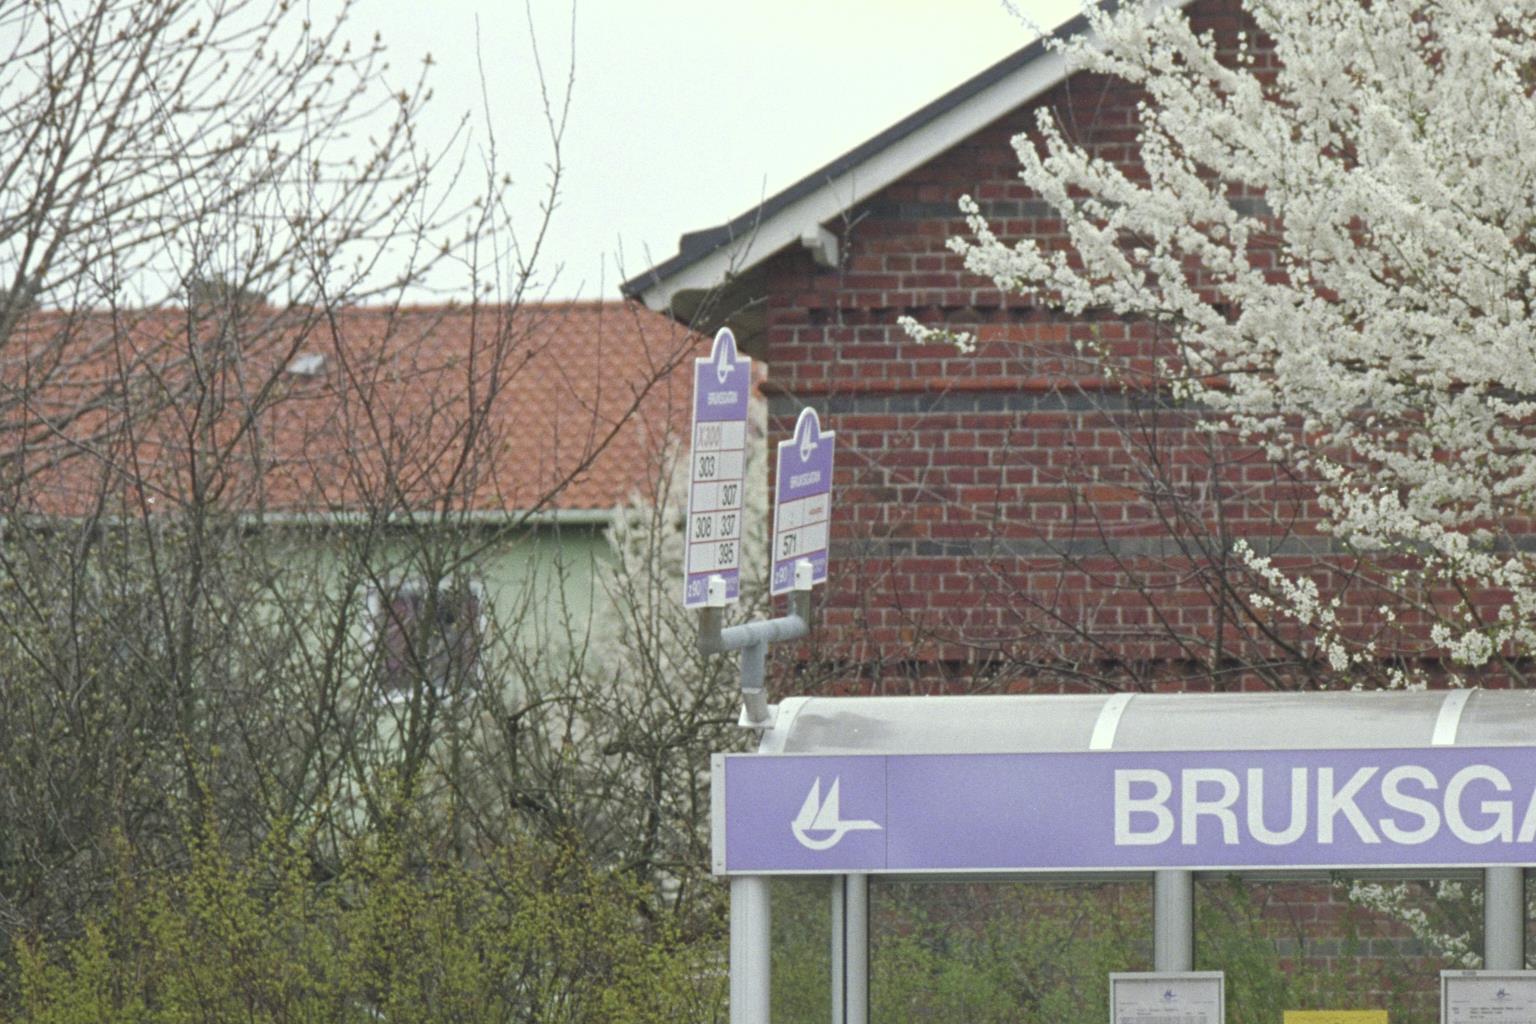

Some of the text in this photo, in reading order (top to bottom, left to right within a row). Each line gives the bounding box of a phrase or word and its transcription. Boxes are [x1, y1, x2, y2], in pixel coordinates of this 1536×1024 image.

[699, 456, 715, 478] 303
[722, 484, 737, 506] 307
[695, 514, 736, 539] 308 337
[782, 533, 797, 556] 571
